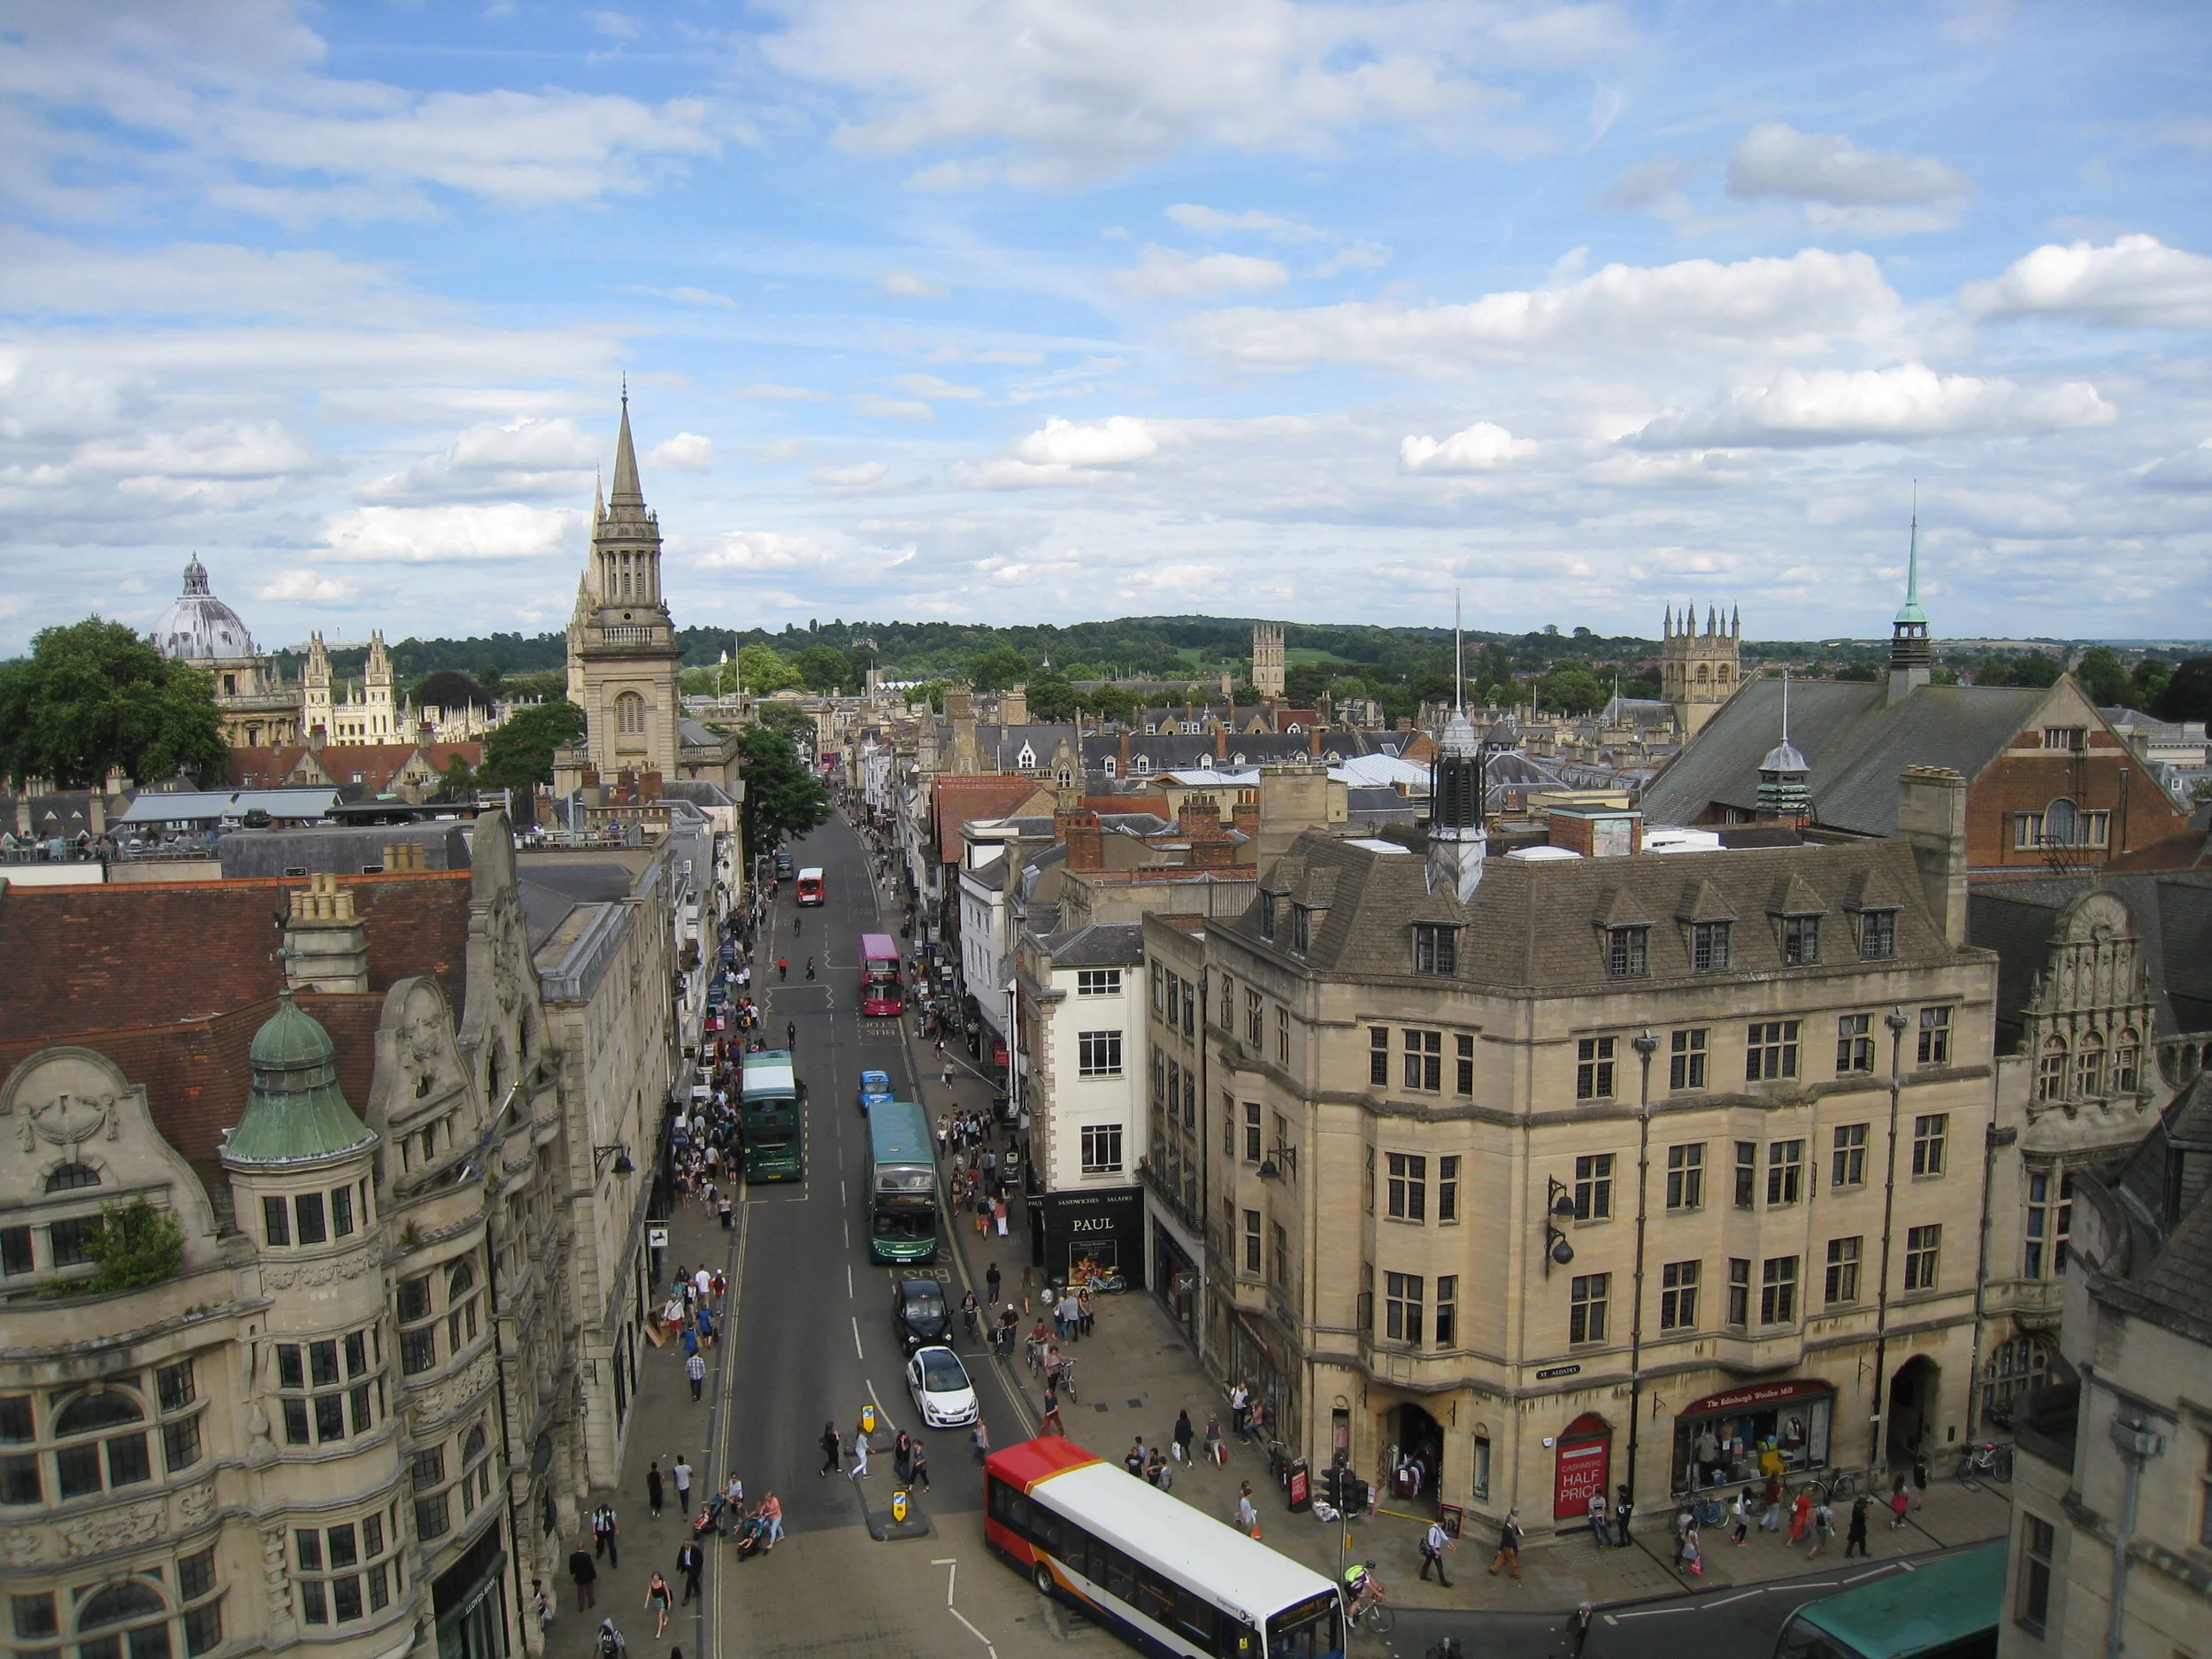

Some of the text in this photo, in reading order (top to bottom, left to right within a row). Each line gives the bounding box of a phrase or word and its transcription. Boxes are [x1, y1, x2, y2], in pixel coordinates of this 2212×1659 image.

[1057, 1197, 1099, 1206] SANDWICHES
[1073, 1217, 1114, 1232] PAUL
[903, 1268, 951, 1283] BUS
[1720, 1394, 1752, 1406] Edinburgh
[1754, 1390, 1778, 1400] Woollen
[1780, 1386, 1793, 1395] Mill
[1562, 1459, 1601, 1472] CASHMERE
[1563, 1469, 1600, 1487] HALF
[465, 1576, 496, 1614] LLOYDS BANK
